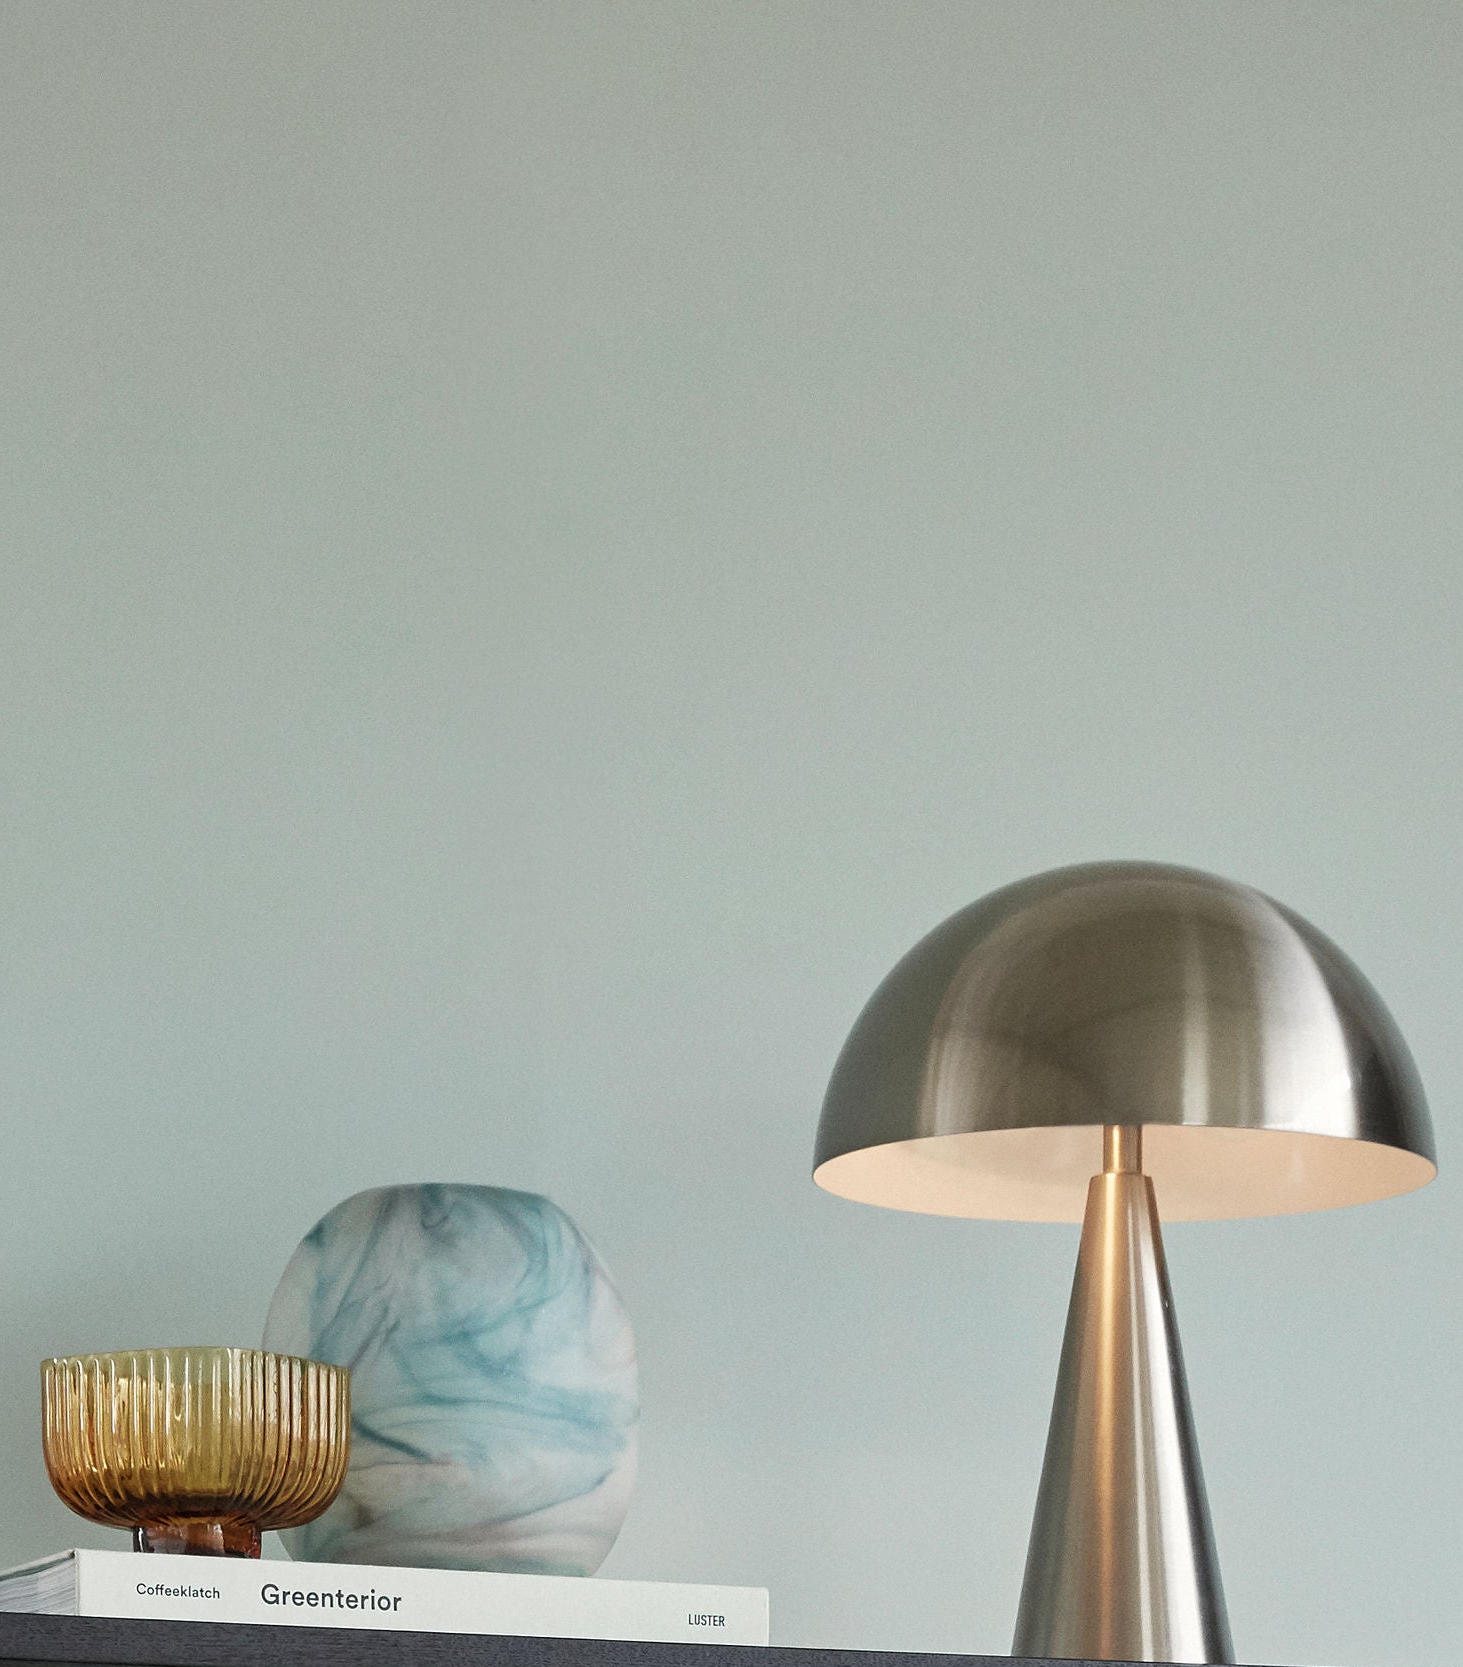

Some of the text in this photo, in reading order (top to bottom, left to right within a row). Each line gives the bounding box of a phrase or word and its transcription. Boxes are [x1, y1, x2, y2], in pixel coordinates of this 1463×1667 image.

[136, 1582, 220, 1599] Coffeeklatch
[261, 1583, 402, 1612] Greenterior
[688, 1613, 725, 1626] LUSTER
